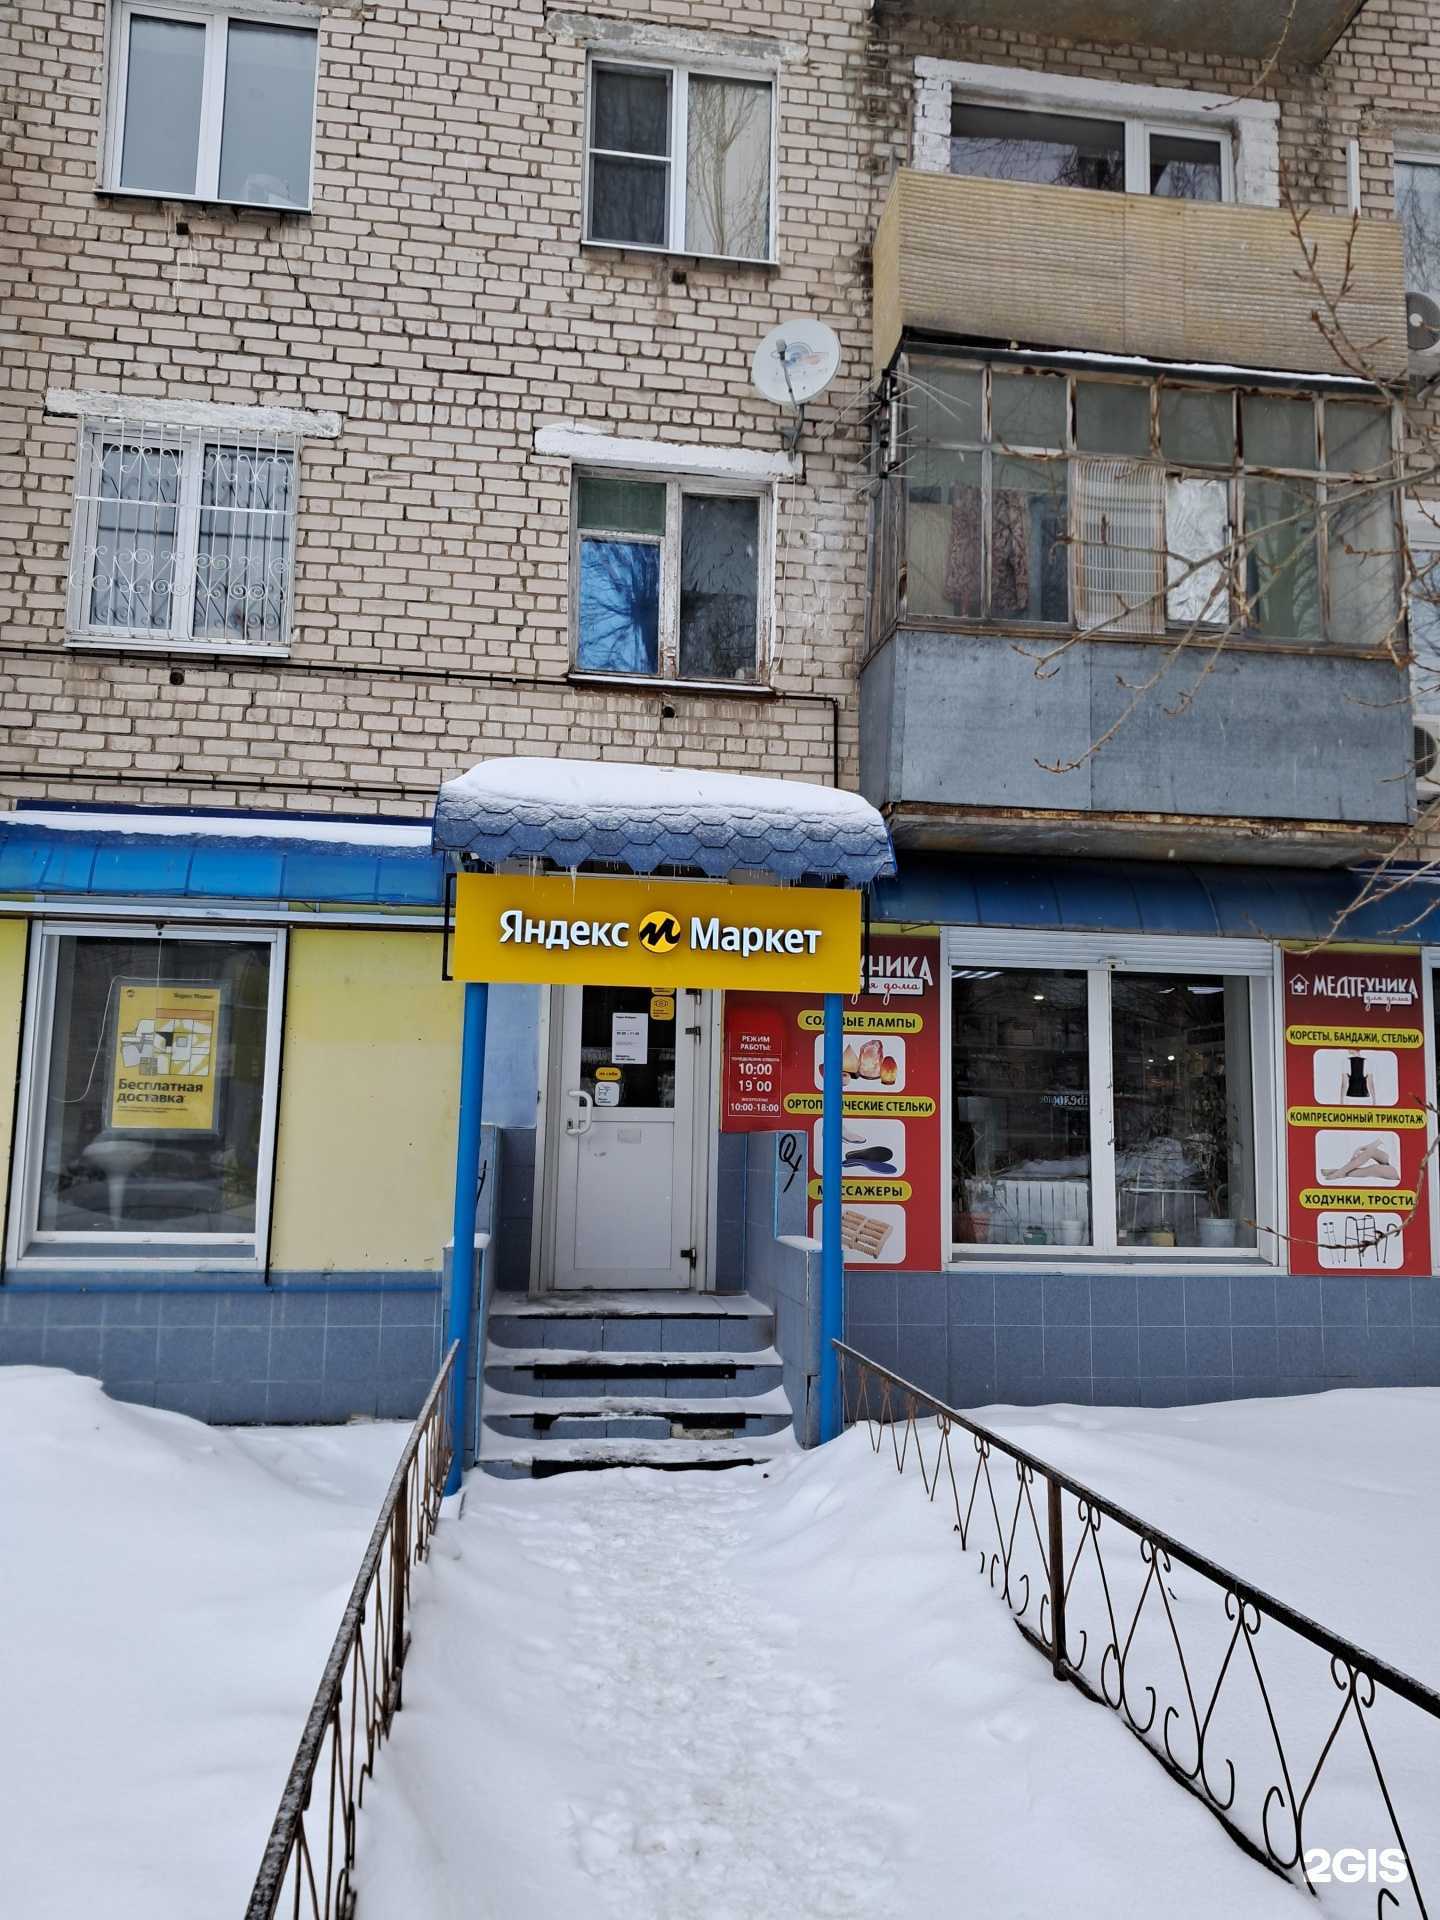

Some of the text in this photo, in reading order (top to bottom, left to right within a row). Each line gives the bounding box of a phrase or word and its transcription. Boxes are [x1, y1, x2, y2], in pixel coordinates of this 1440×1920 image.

[499, 910, 630, 950] Яндекс
[690, 917, 822, 957] Маркет
[1313, 975, 1419, 999] МЕДТЕХНИКА
[868, 1017, 916, 1029] ЛАМПЫ
[742, 1035, 770, 1043] РЕЖИМ
[1334, 1031, 1380, 1044] БАНДАЖИ,
[1381, 1033, 1420, 1044] СТЕЛЬКИ
[739, 1063, 773, 1075] 10:00
[118, 1078, 203, 1093] Бесплатная
[787, 1099, 933, 1112] ОРТОПЧЕСКИЕ СТЕЛЬКИ
[1290, 1112, 1424, 1124] КОМПРЕСИОННЫЙ ТРИКОТАЖ
[817, 1185, 903, 1197] МССАЖЕРЫ
[1305, 1194, 1415, 1206] ХОДУНКИ, ТРОСТИ
